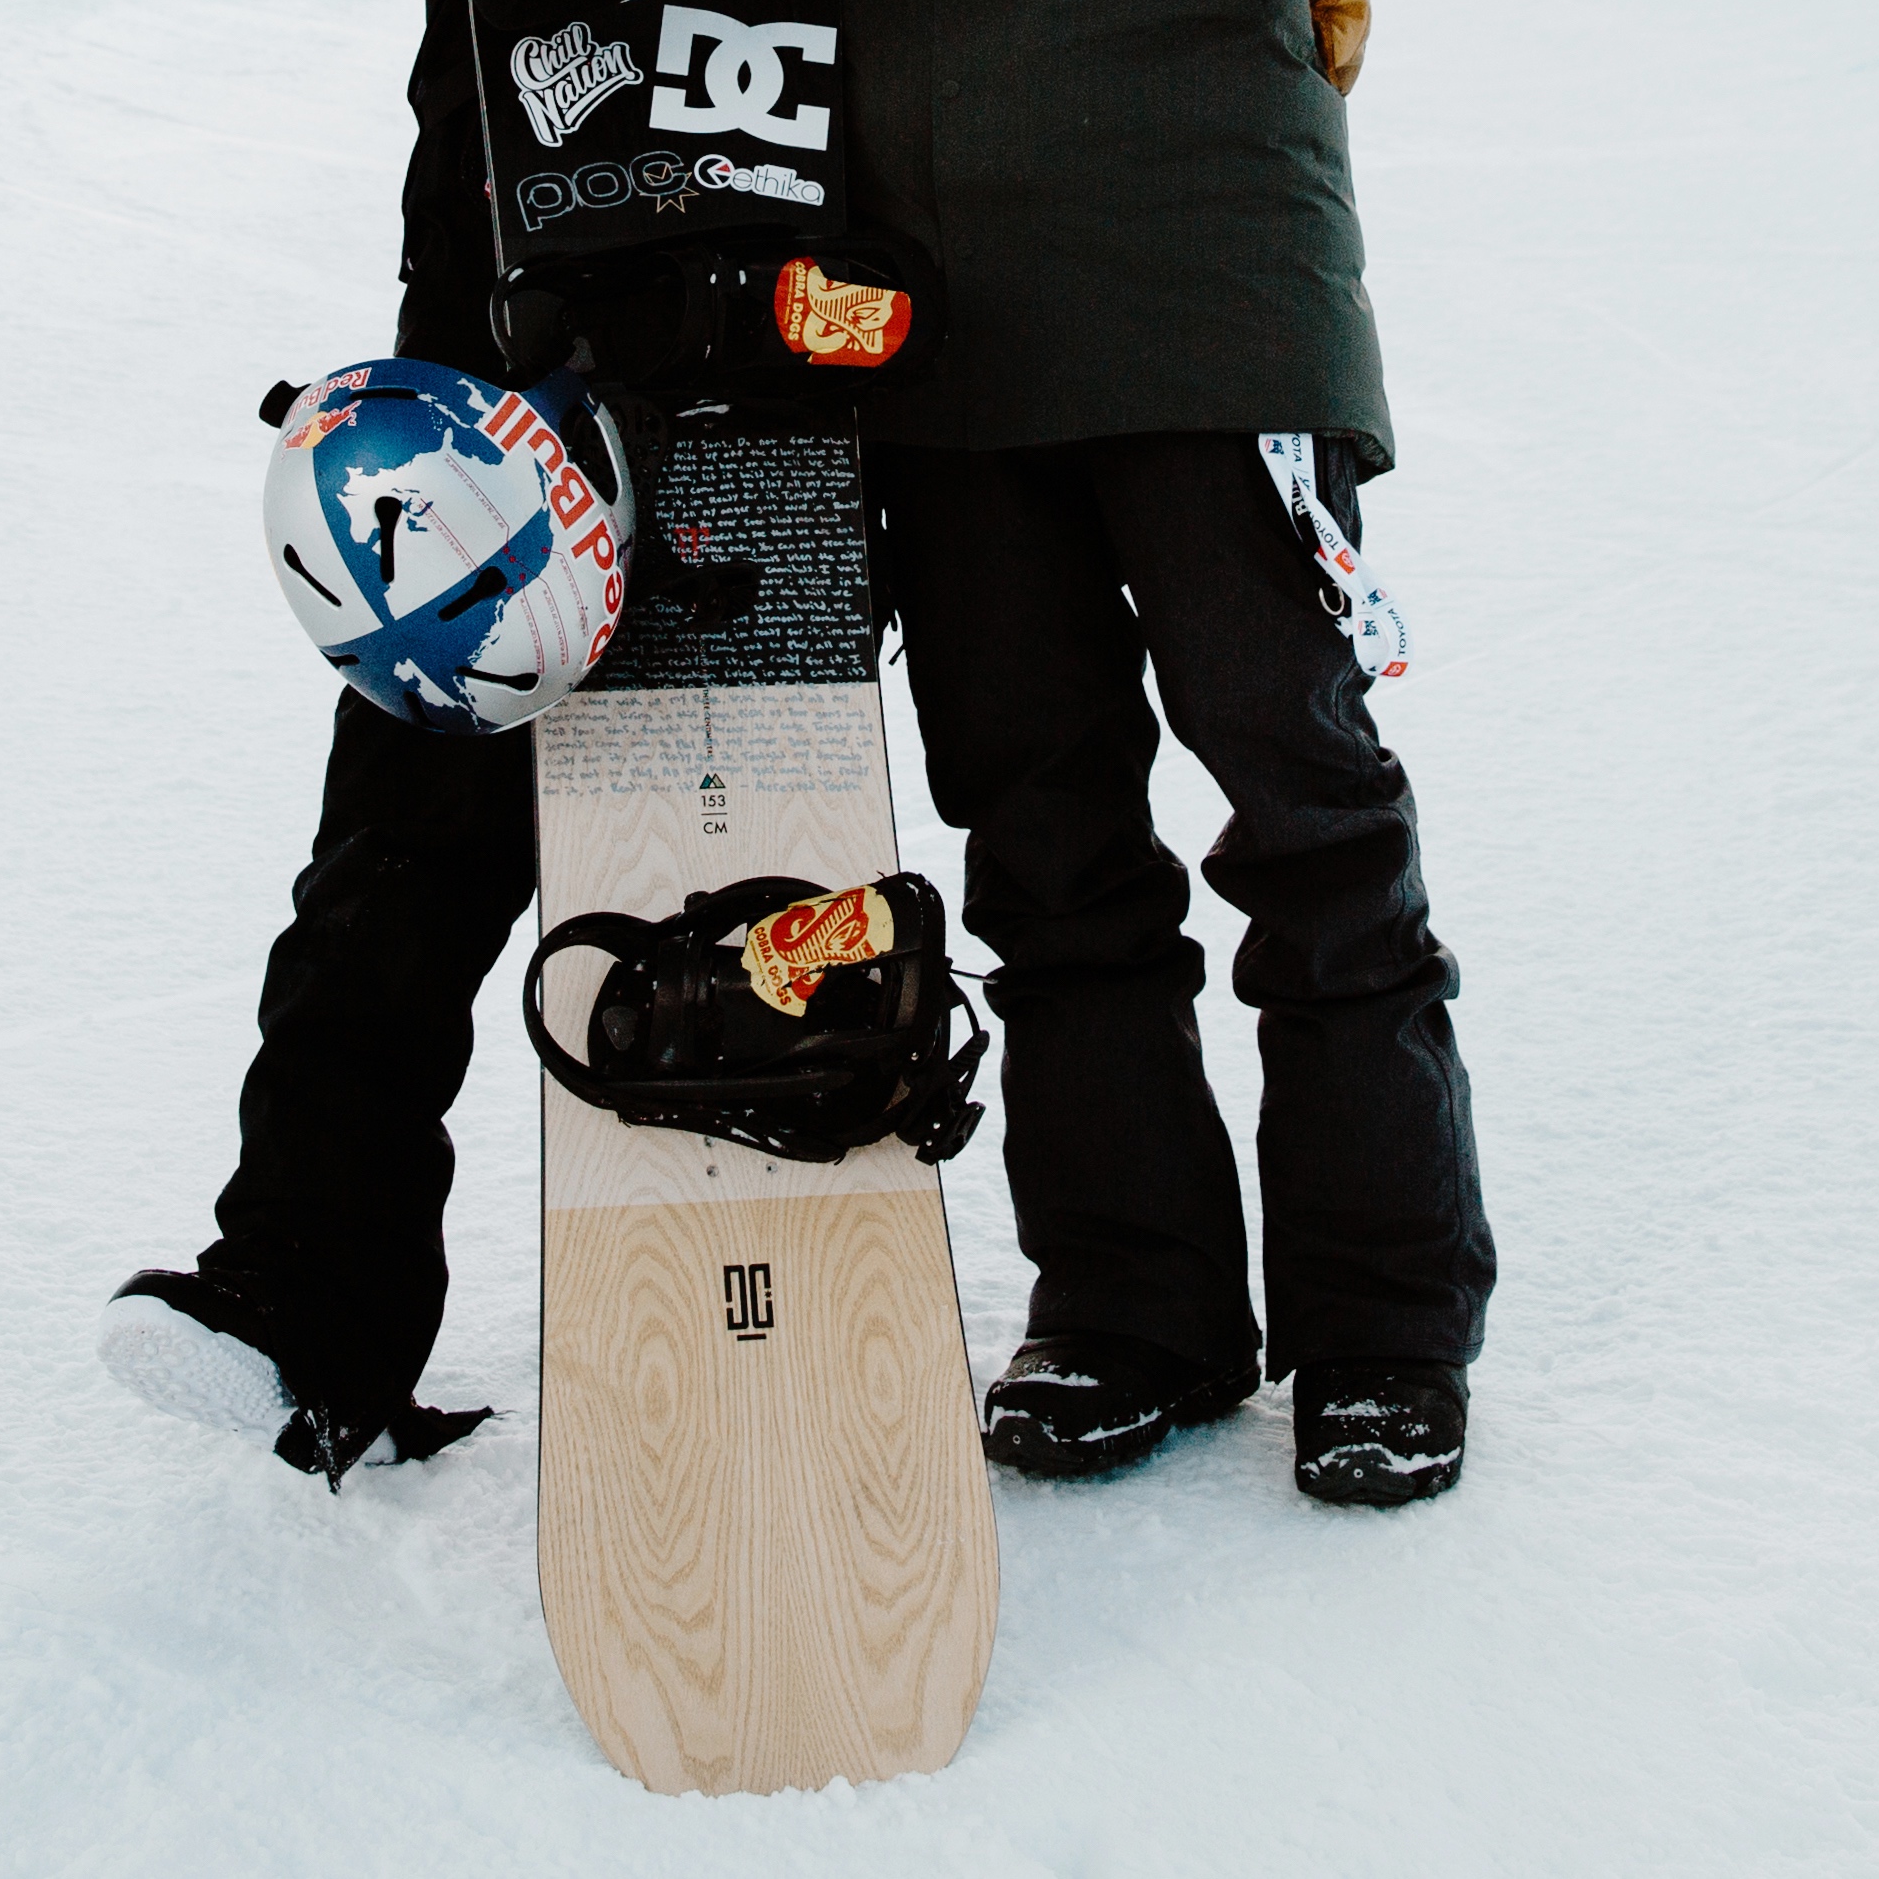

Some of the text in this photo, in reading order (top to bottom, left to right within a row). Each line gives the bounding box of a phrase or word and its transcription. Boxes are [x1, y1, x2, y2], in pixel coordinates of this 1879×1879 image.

[512, 22, 594, 90] Chill
[649, 4, 837, 151] DC
[519, 42, 642, 147] Nation
[729, 164, 824, 205] ethika
[793, 261, 807, 299] COBRA
[787, 302, 804, 341] DOGS
[286, 367, 372, 427] Red Bull
[482, 391, 598, 532] Bull
[570, 513, 625, 673] Red
[1387, 607, 1407, 657] TOYOTA
[700, 793, 727, 808] 153
[702, 820, 729, 835] CM
[753, 926, 775, 964] COBRA
